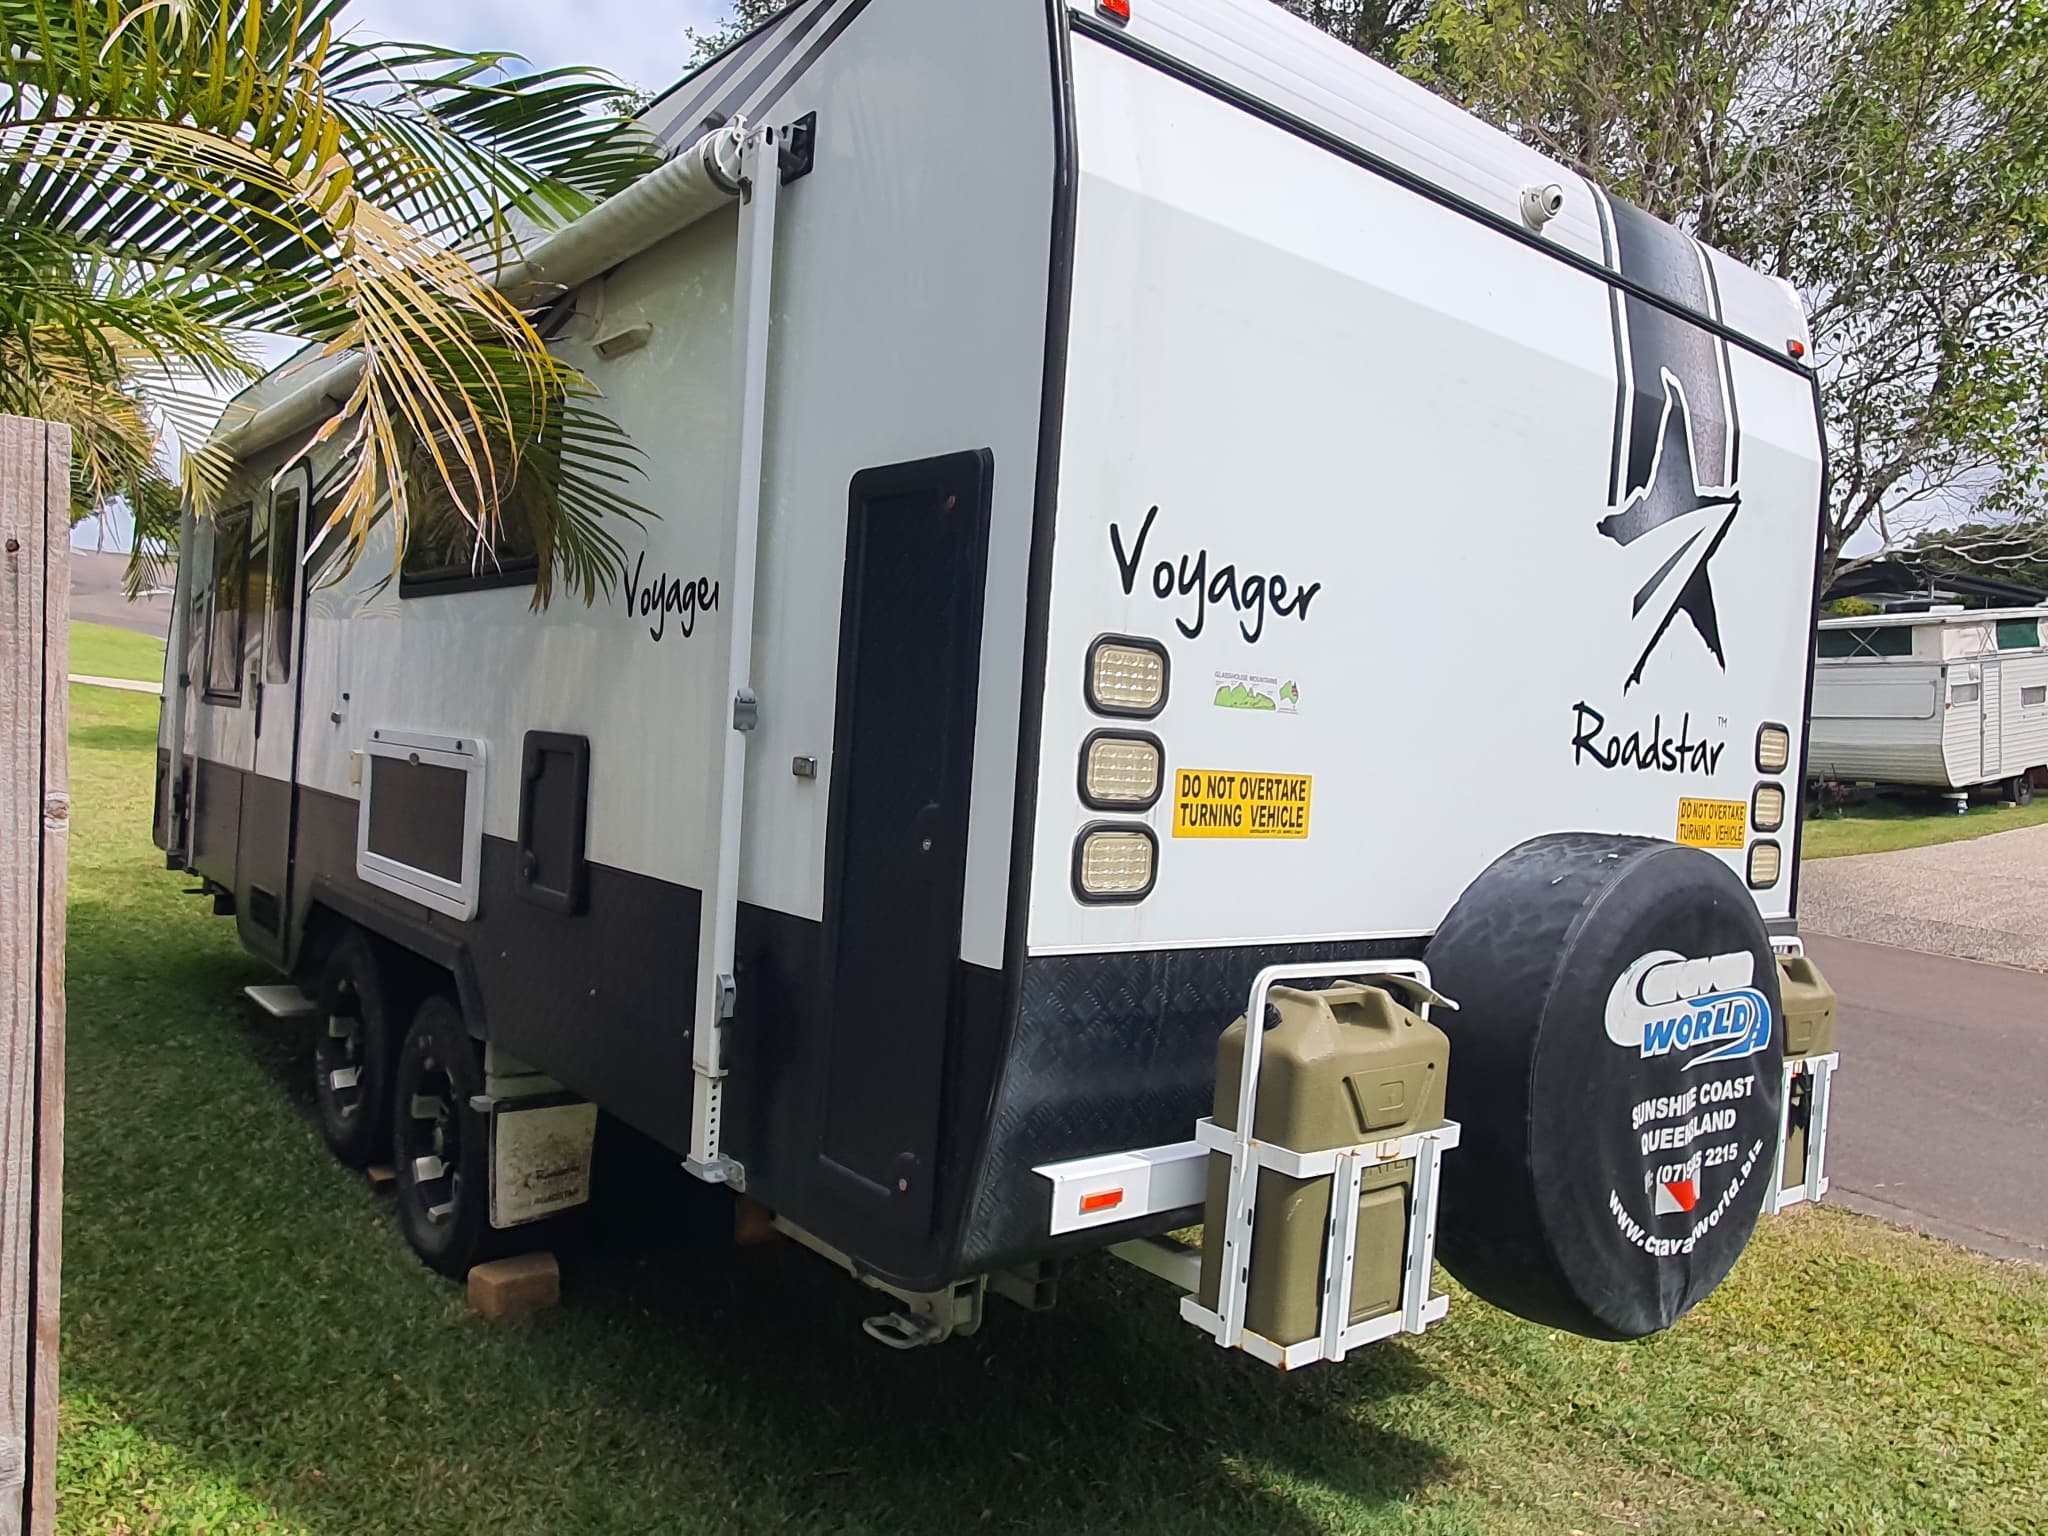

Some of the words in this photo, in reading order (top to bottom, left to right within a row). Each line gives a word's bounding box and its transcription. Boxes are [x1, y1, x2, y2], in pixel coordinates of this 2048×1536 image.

[1109, 505, 1321, 644] Voyager
[1571, 700, 1725, 776] Roadstar
[1182, 774, 1201, 798] DO
[1206, 775, 1236, 799] NOT
[1239, 777, 1307, 802] OVERTAKE
[1180, 803, 1242, 827] TURNING
[1250, 805, 1304, 828] VEHICLE
[1681, 802, 1692, 818] DO
[1693, 803, 1708, 818] NOT
[1709, 804, 1744, 821] OVERTAKE
[1680, 823, 1711, 840] TURNING
[1715, 824, 1743, 841] VEHICLE
[1643, 1003, 1749, 1053] WORLD
[1632, 1086, 1698, 1130] SUNSHIE
[1700, 1075, 1755, 1105] COAST
[1704, 1143, 1739, 1167] 2215
